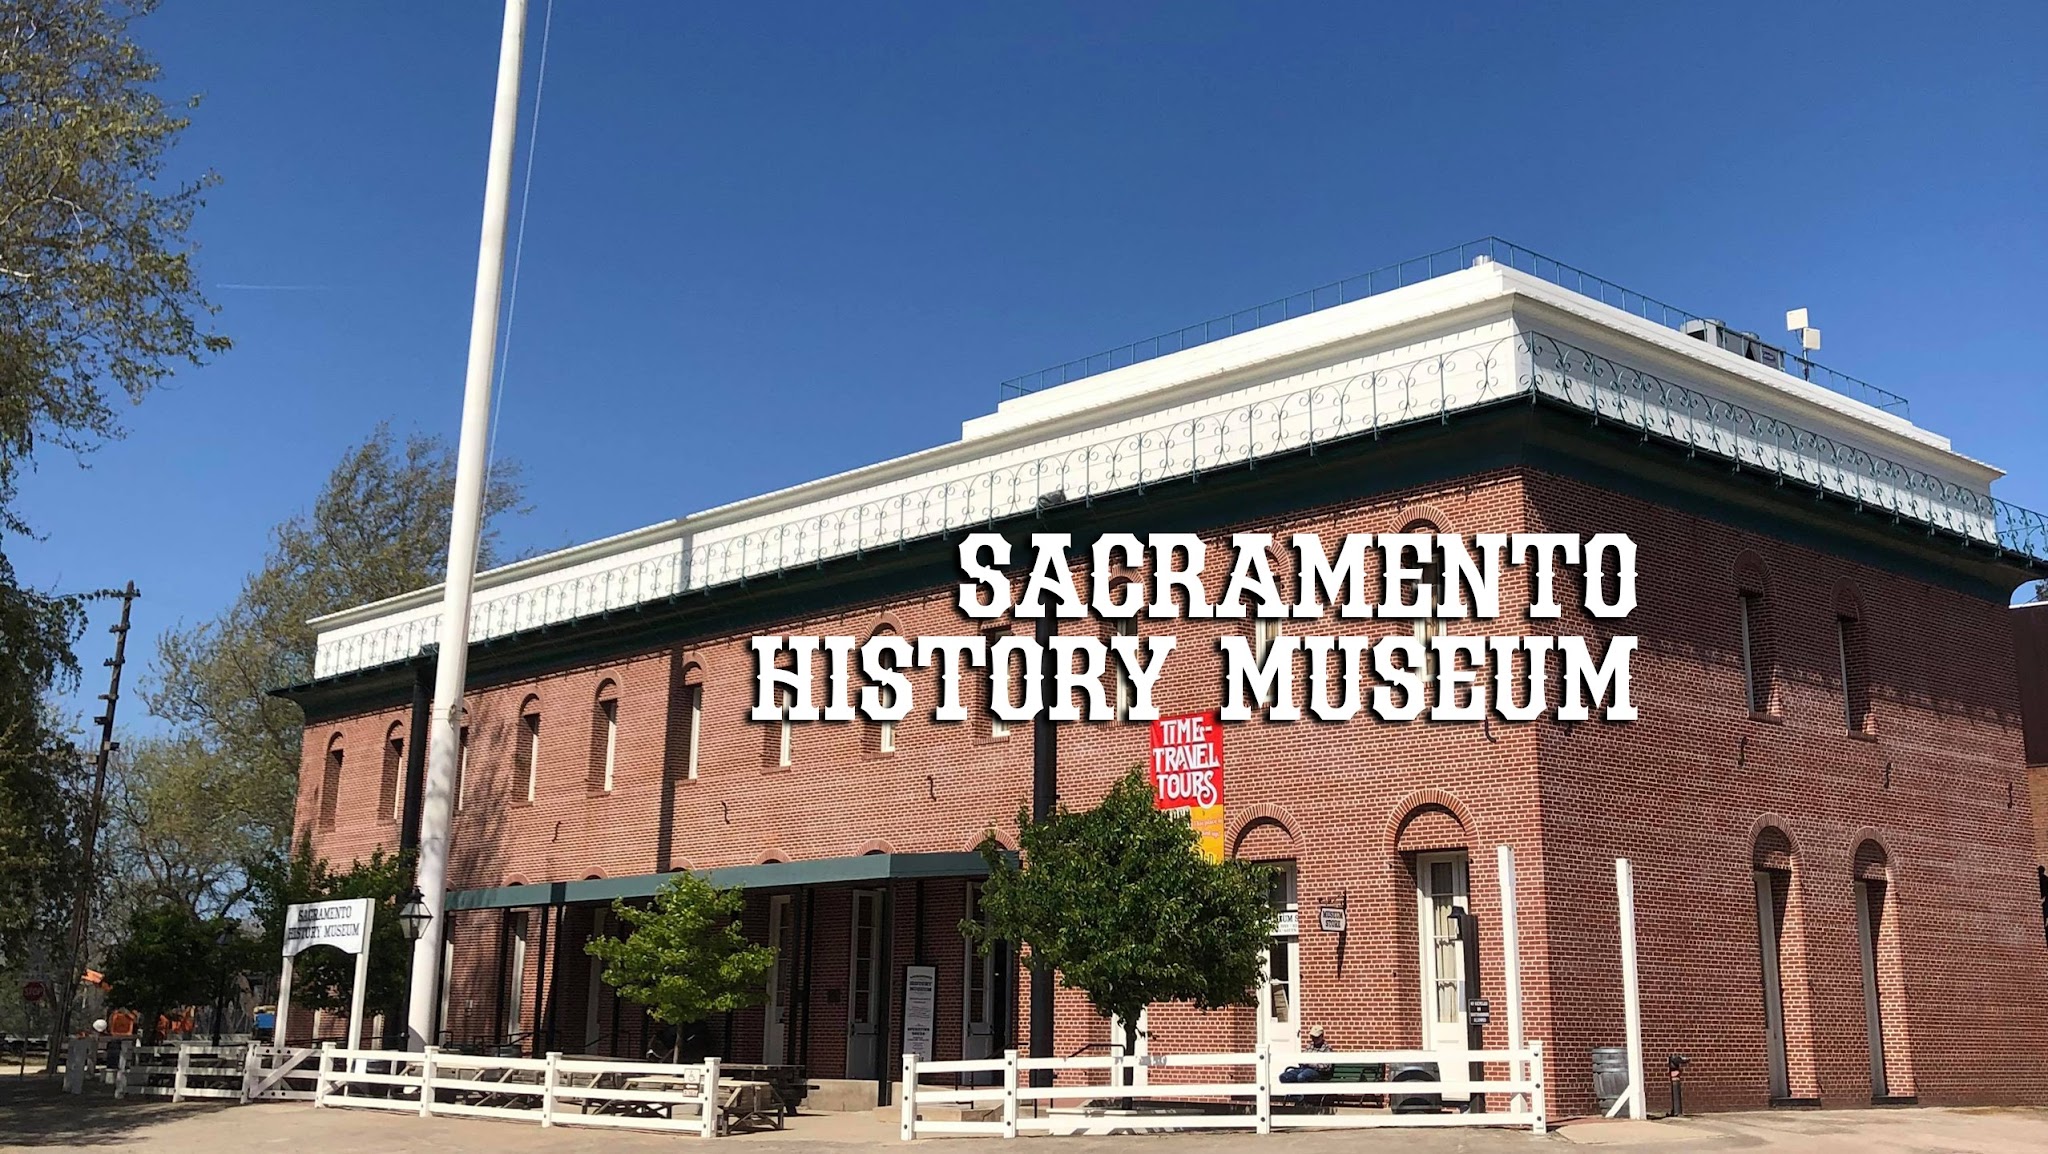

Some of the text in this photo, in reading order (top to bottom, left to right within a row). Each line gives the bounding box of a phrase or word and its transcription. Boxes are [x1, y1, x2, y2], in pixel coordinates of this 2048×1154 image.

[1160, 717, 1213, 746] TIME-
[1153, 742, 1221, 773] TRAVEL
[1156, 770, 1218, 810] TOURS
[298, 906, 352, 922] SACRAMENTO
[1322, 910, 1343, 920] MUSEUM
[287, 923, 360, 940] HISTORY MUSEUM
[1325, 919, 1341, 928] STORE
[25, 986, 44, 996] STOP
